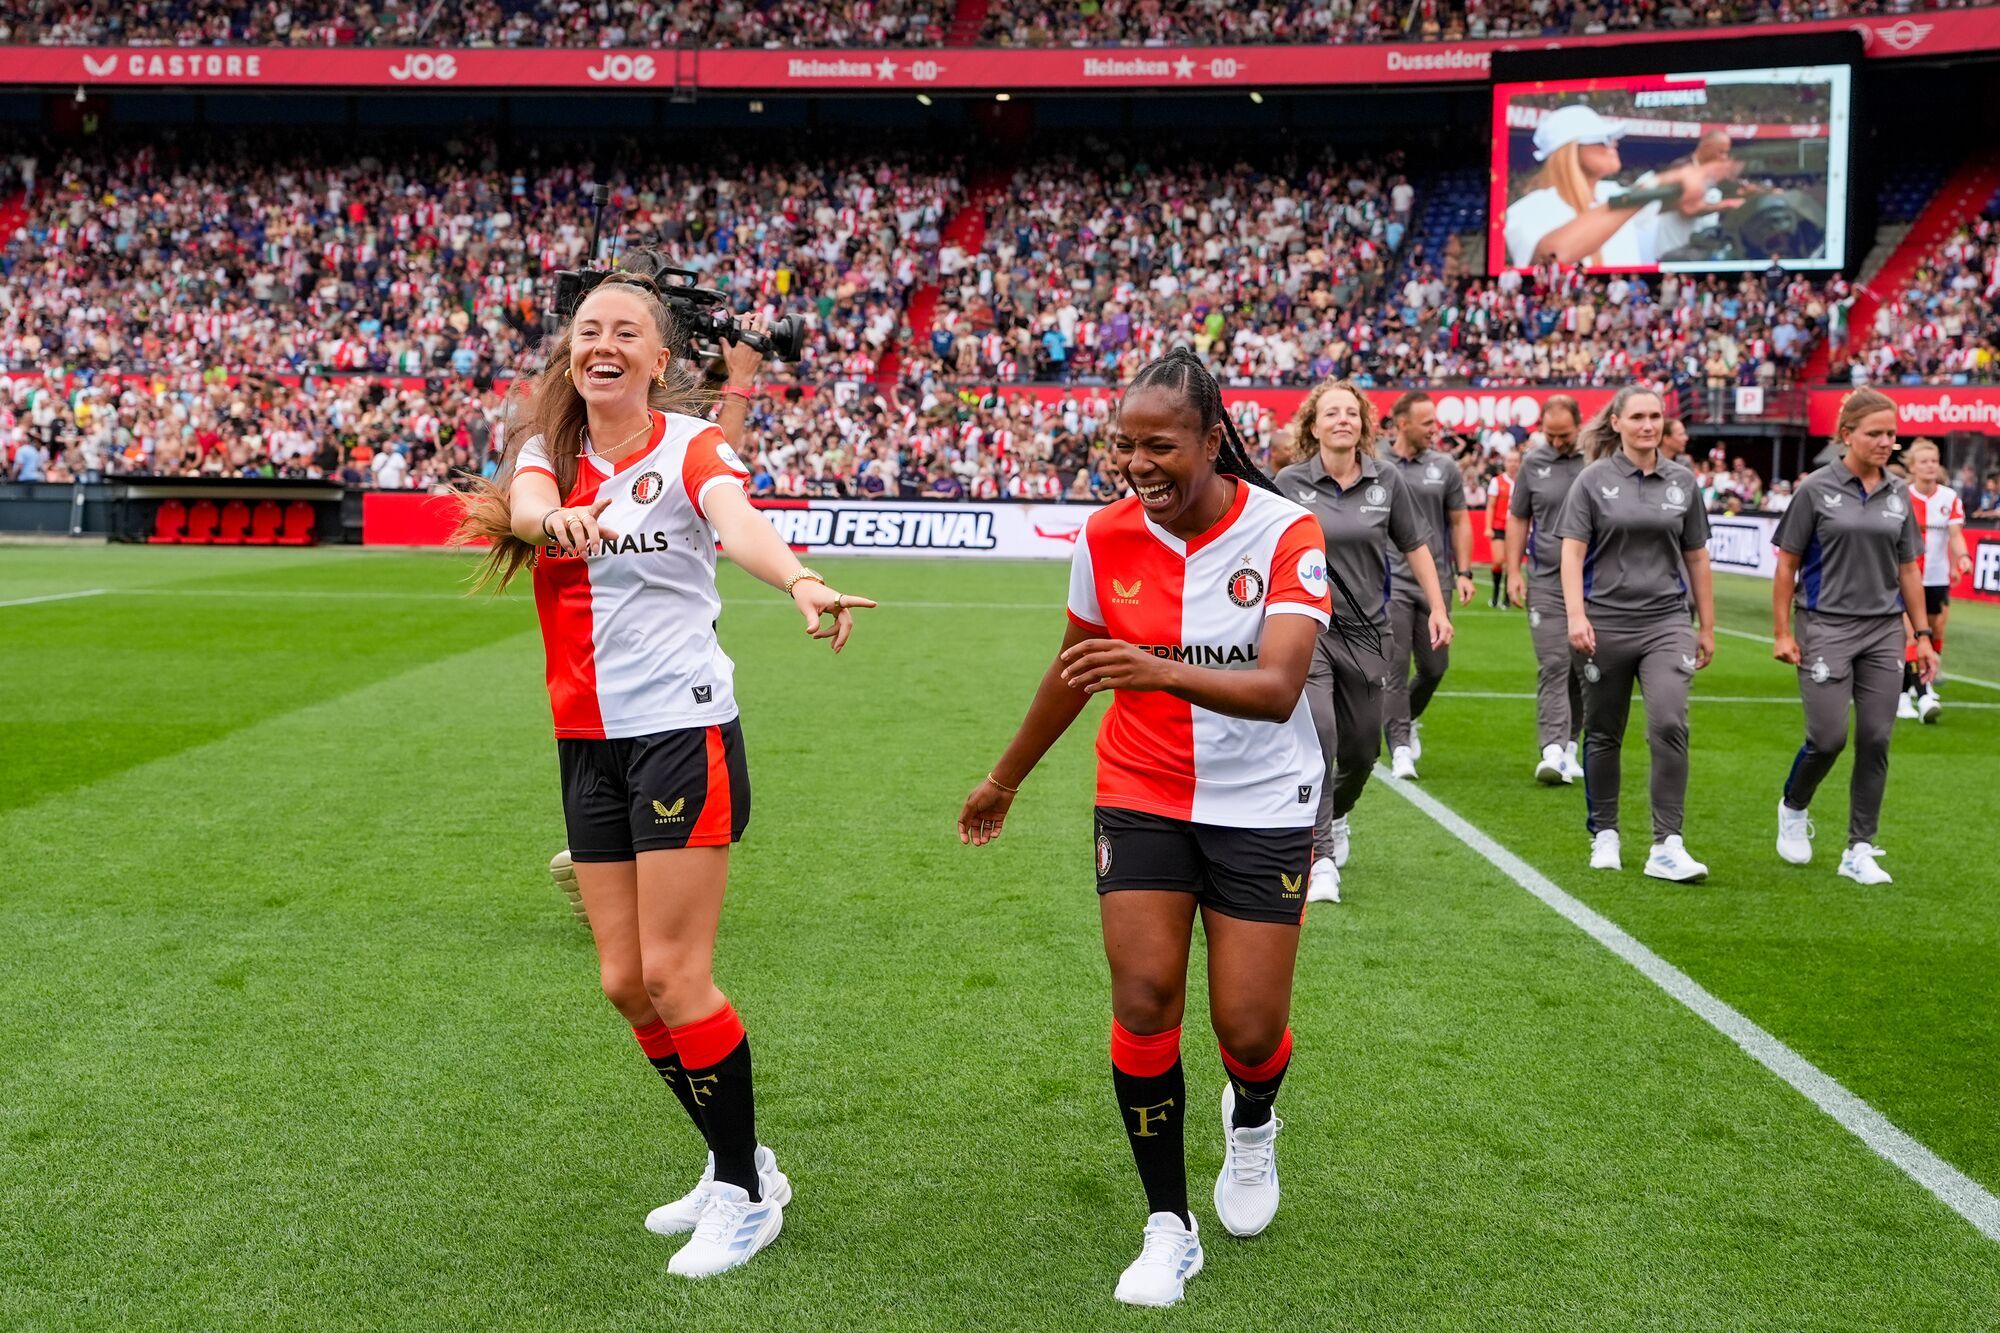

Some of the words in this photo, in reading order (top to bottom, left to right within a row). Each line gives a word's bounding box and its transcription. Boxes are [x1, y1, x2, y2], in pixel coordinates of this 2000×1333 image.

[129, 55, 260, 76] CASTORE
[788, 59, 872, 77] Heineken
[1084, 57, 1169, 76] Heineken
[834, 511, 994, 548] FESTIVAL
[1229, 591, 1263, 607] ROTTERDAM
[1130, 1098, 1174, 1137] F
